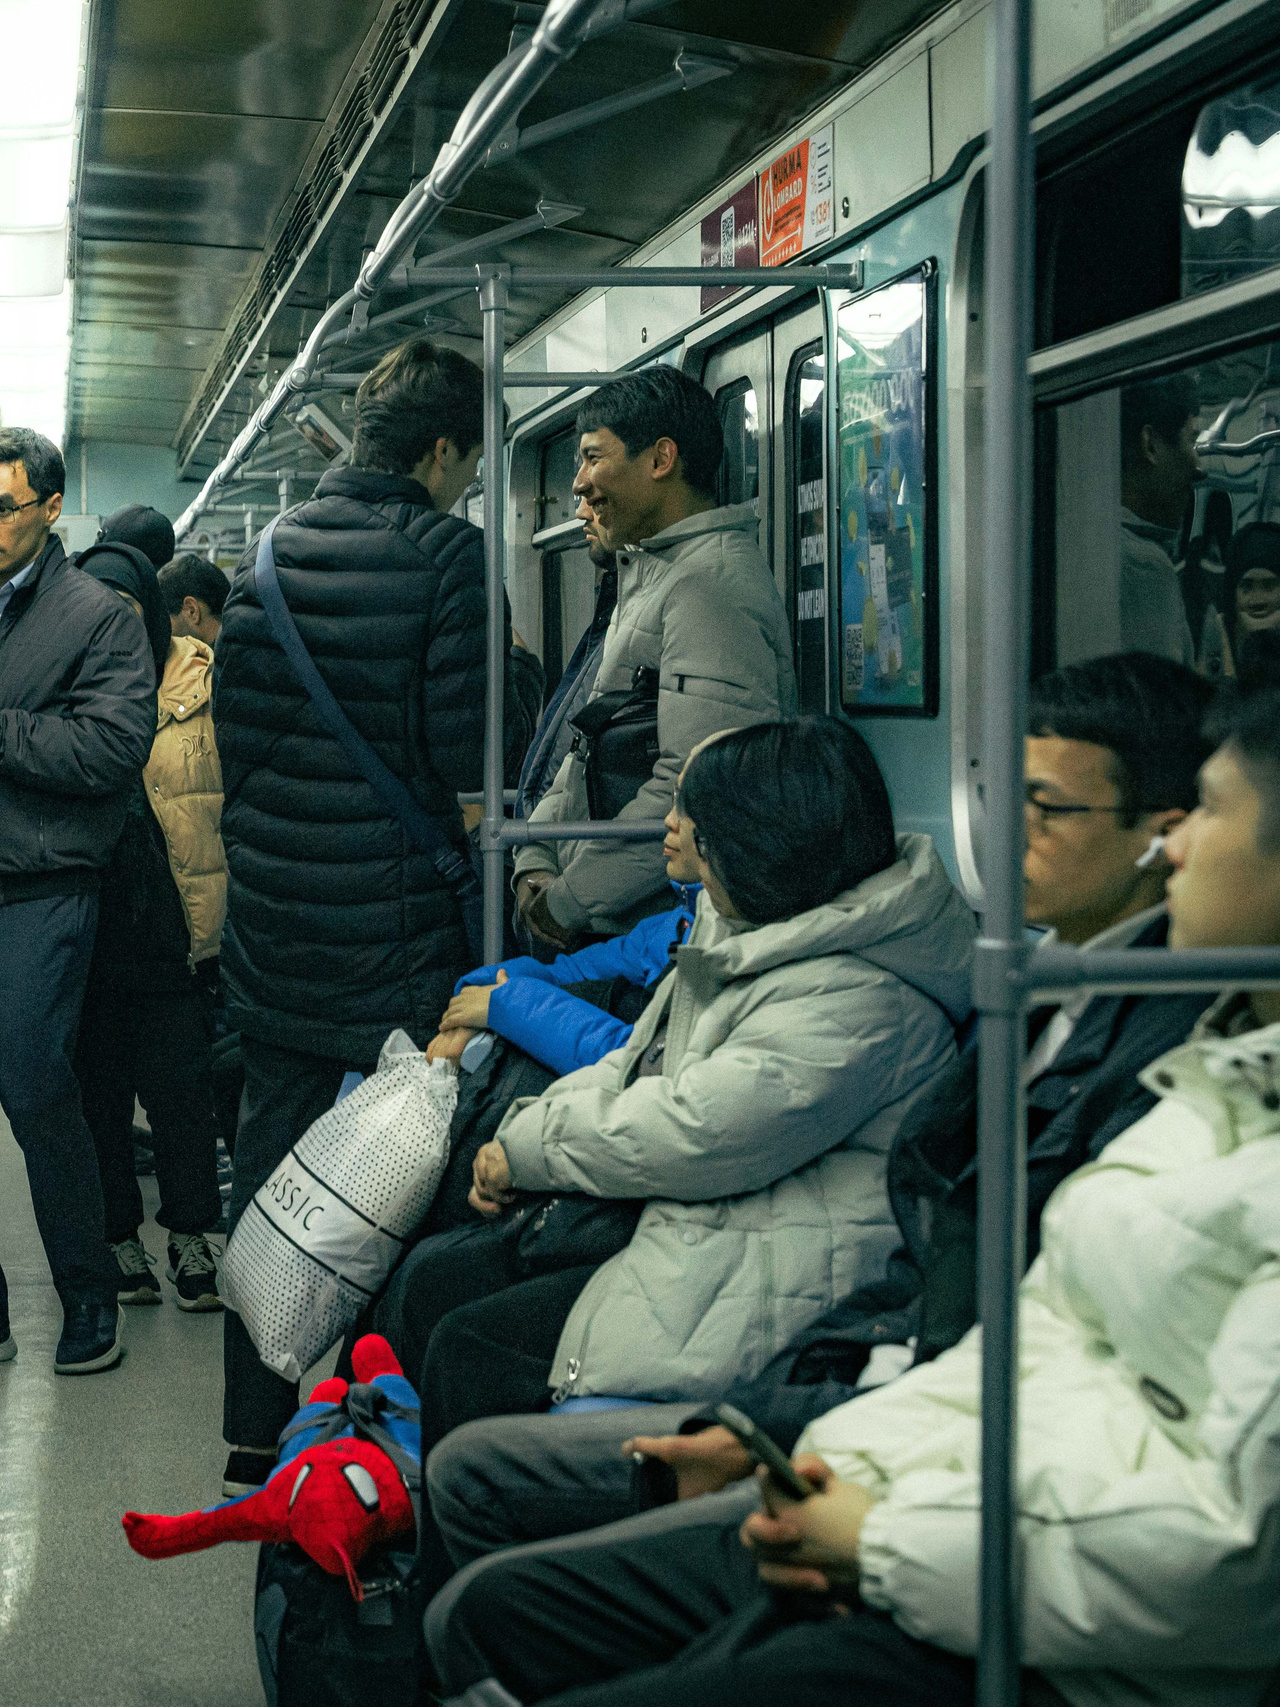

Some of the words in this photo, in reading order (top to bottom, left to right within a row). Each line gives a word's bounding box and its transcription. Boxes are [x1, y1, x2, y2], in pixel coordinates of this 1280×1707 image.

[773, 148, 802, 188] HURMA
[773, 177, 803, 212] LOMBARD
[265, 1171, 325, 1231] ASSIC
